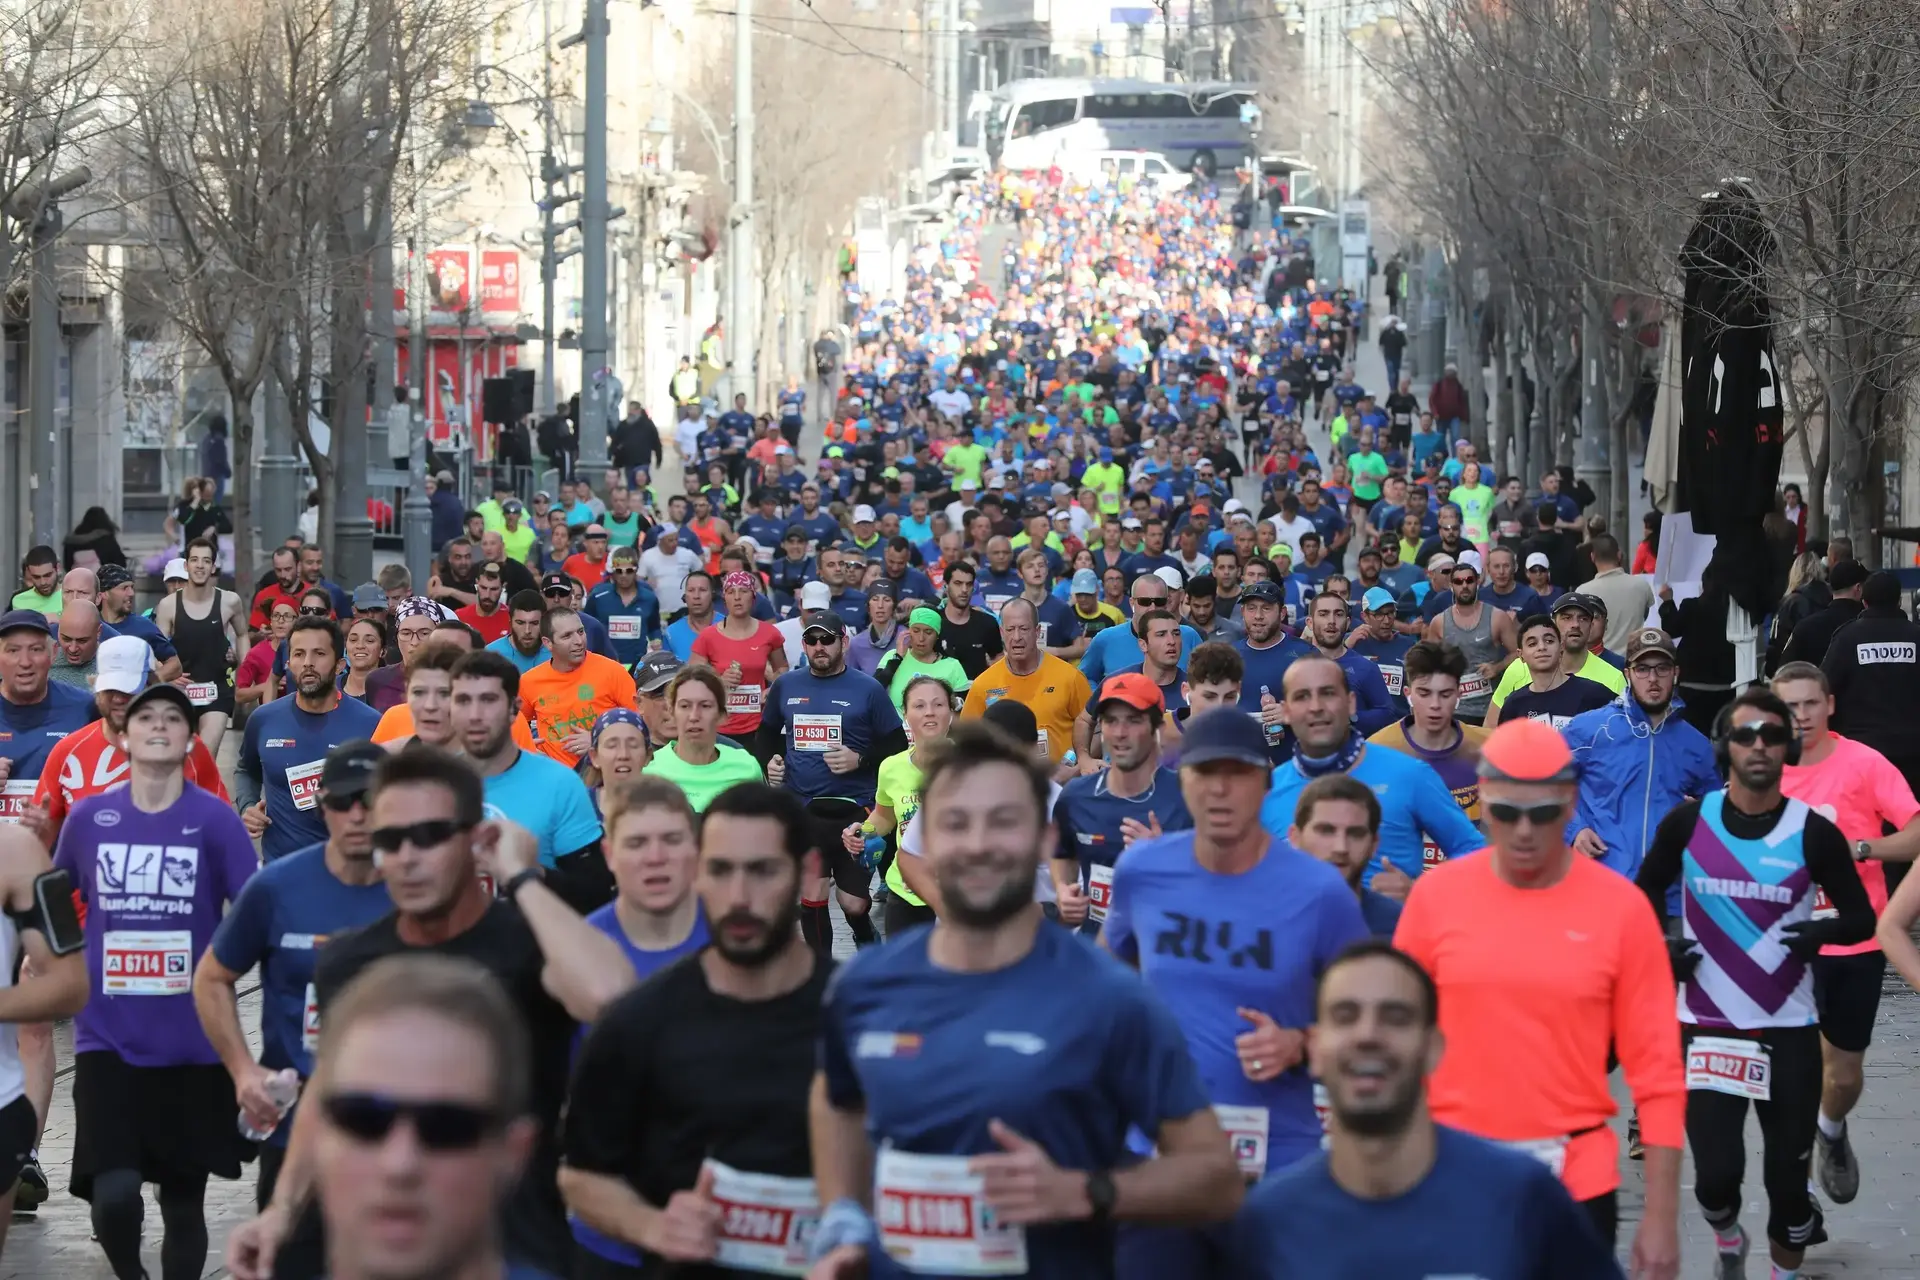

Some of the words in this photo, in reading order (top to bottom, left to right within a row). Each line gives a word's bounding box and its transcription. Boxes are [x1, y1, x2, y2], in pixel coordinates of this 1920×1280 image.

[1860, 647, 1914, 660] משטרה
[797, 728, 803, 737] B
[805, 728, 825, 738] 4530
[294, 784, 302, 793] C
[1425, 849, 1433, 858] C
[1092, 888, 1101, 900] B
[1693, 876, 1793, 904] TRIHARD
[98, 896, 194, 915] Run4Purple
[110, 958, 119, 969] A
[124, 954, 160, 973] 6714
